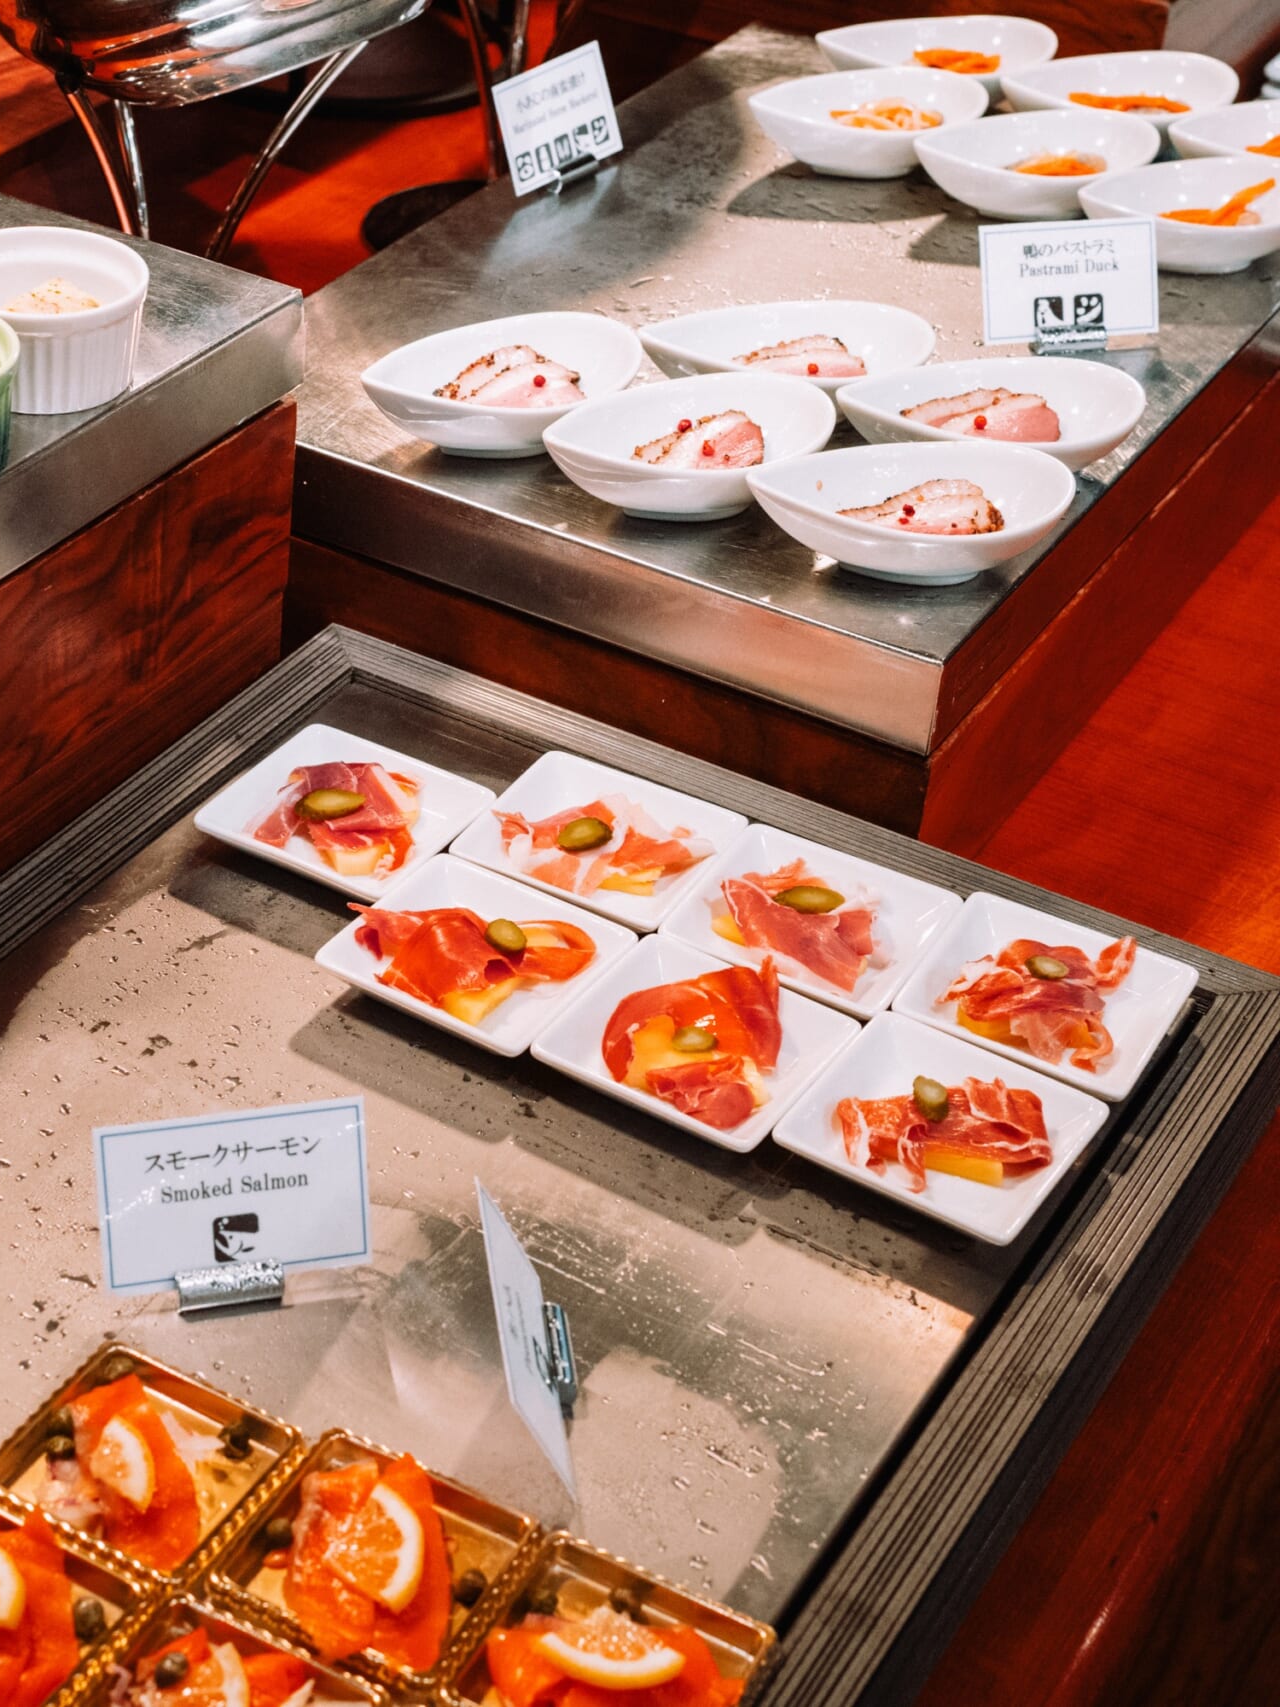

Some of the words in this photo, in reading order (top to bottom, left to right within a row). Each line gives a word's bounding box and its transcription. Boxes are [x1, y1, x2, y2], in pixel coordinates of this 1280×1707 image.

[1019, 260, 1079, 278] Pastrami
[1085, 256, 1119, 274] Duck
[144, 1136, 322, 1174] スモークサーモン
[160, 1177, 233, 1204] Smoked
[240, 1172, 309, 1194] Salmon
